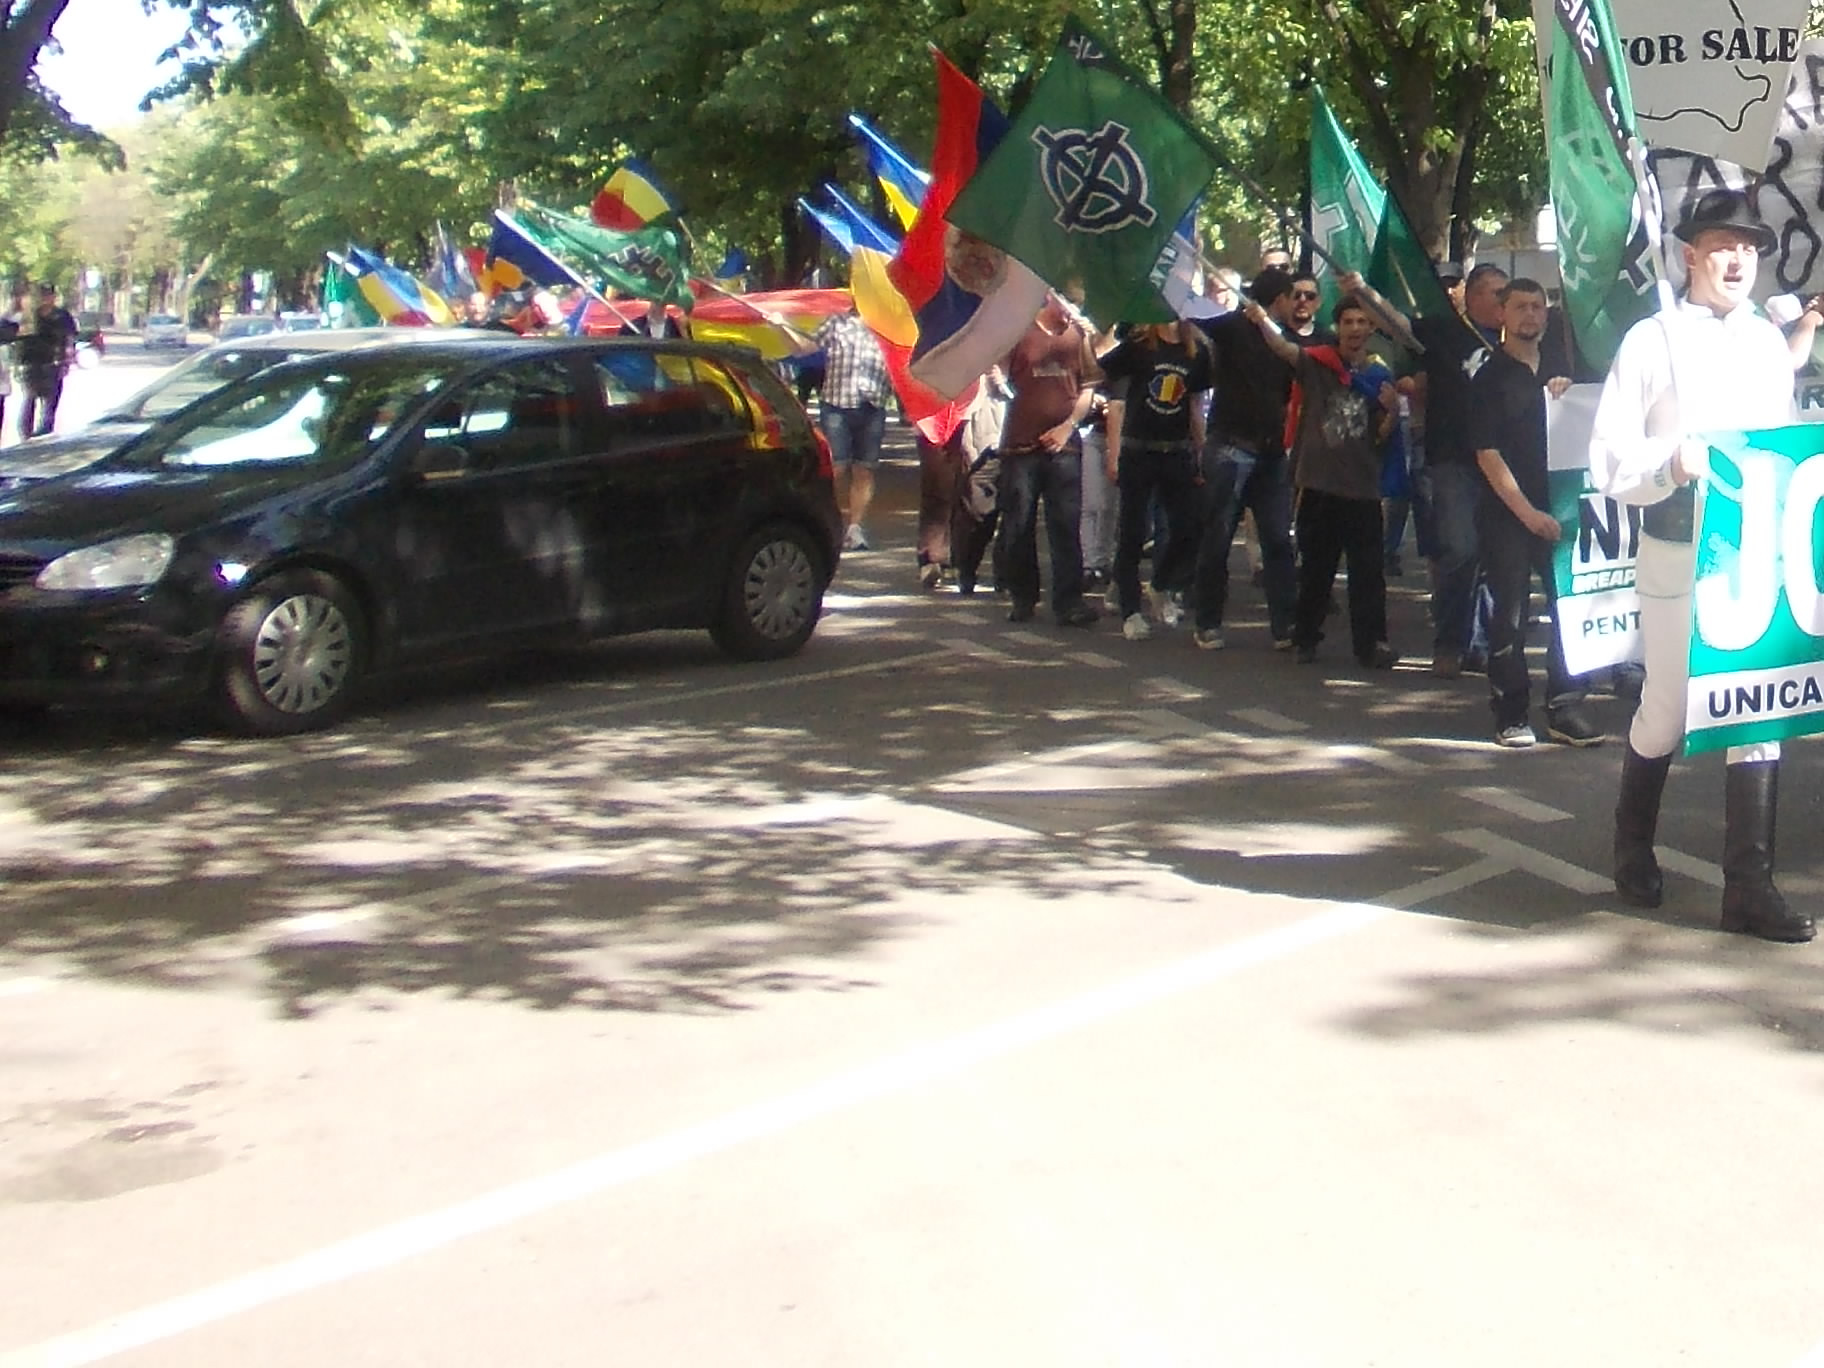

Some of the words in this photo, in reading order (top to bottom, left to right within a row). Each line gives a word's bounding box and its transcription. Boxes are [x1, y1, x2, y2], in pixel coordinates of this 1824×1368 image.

[1622, 34, 1688, 67] OR
[1702, 25, 1800, 65] SALE
[1707, 675, 1823, 720] UNICA
